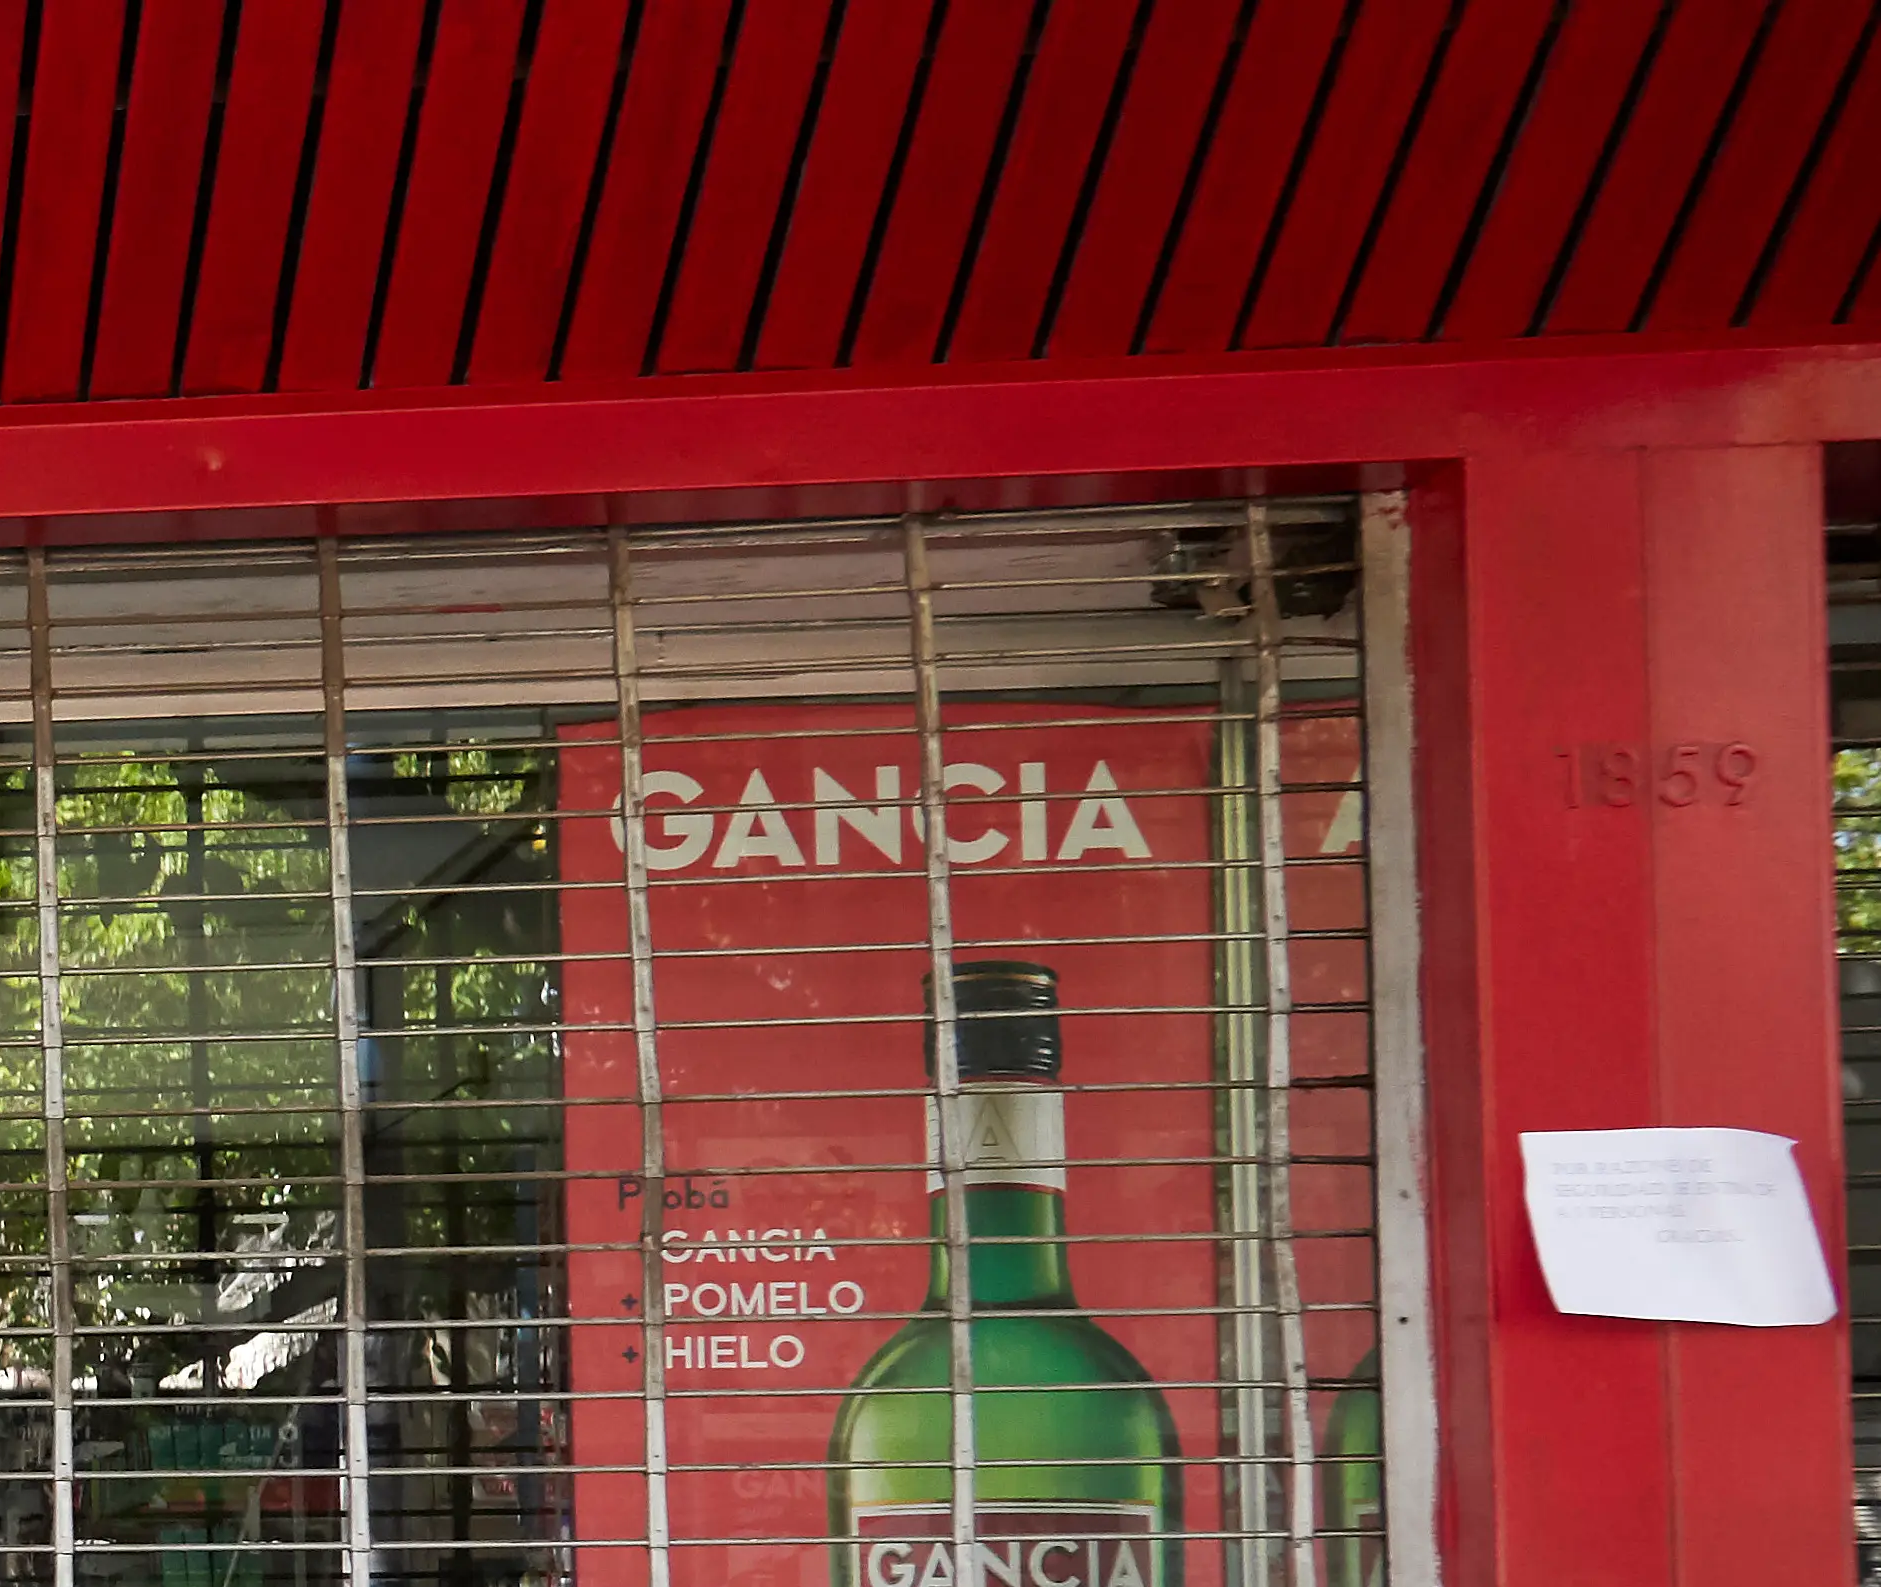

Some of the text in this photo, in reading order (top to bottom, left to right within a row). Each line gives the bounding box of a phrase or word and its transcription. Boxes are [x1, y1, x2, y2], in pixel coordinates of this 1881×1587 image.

[610, 760, 1152, 872] GANCIA
[616, 1178, 730, 1211] Pobá
[660, 1228, 836, 1264] GANCIA
[664, 1281, 865, 1317] POMELO
[664, 1334, 805, 1369] HIELO
